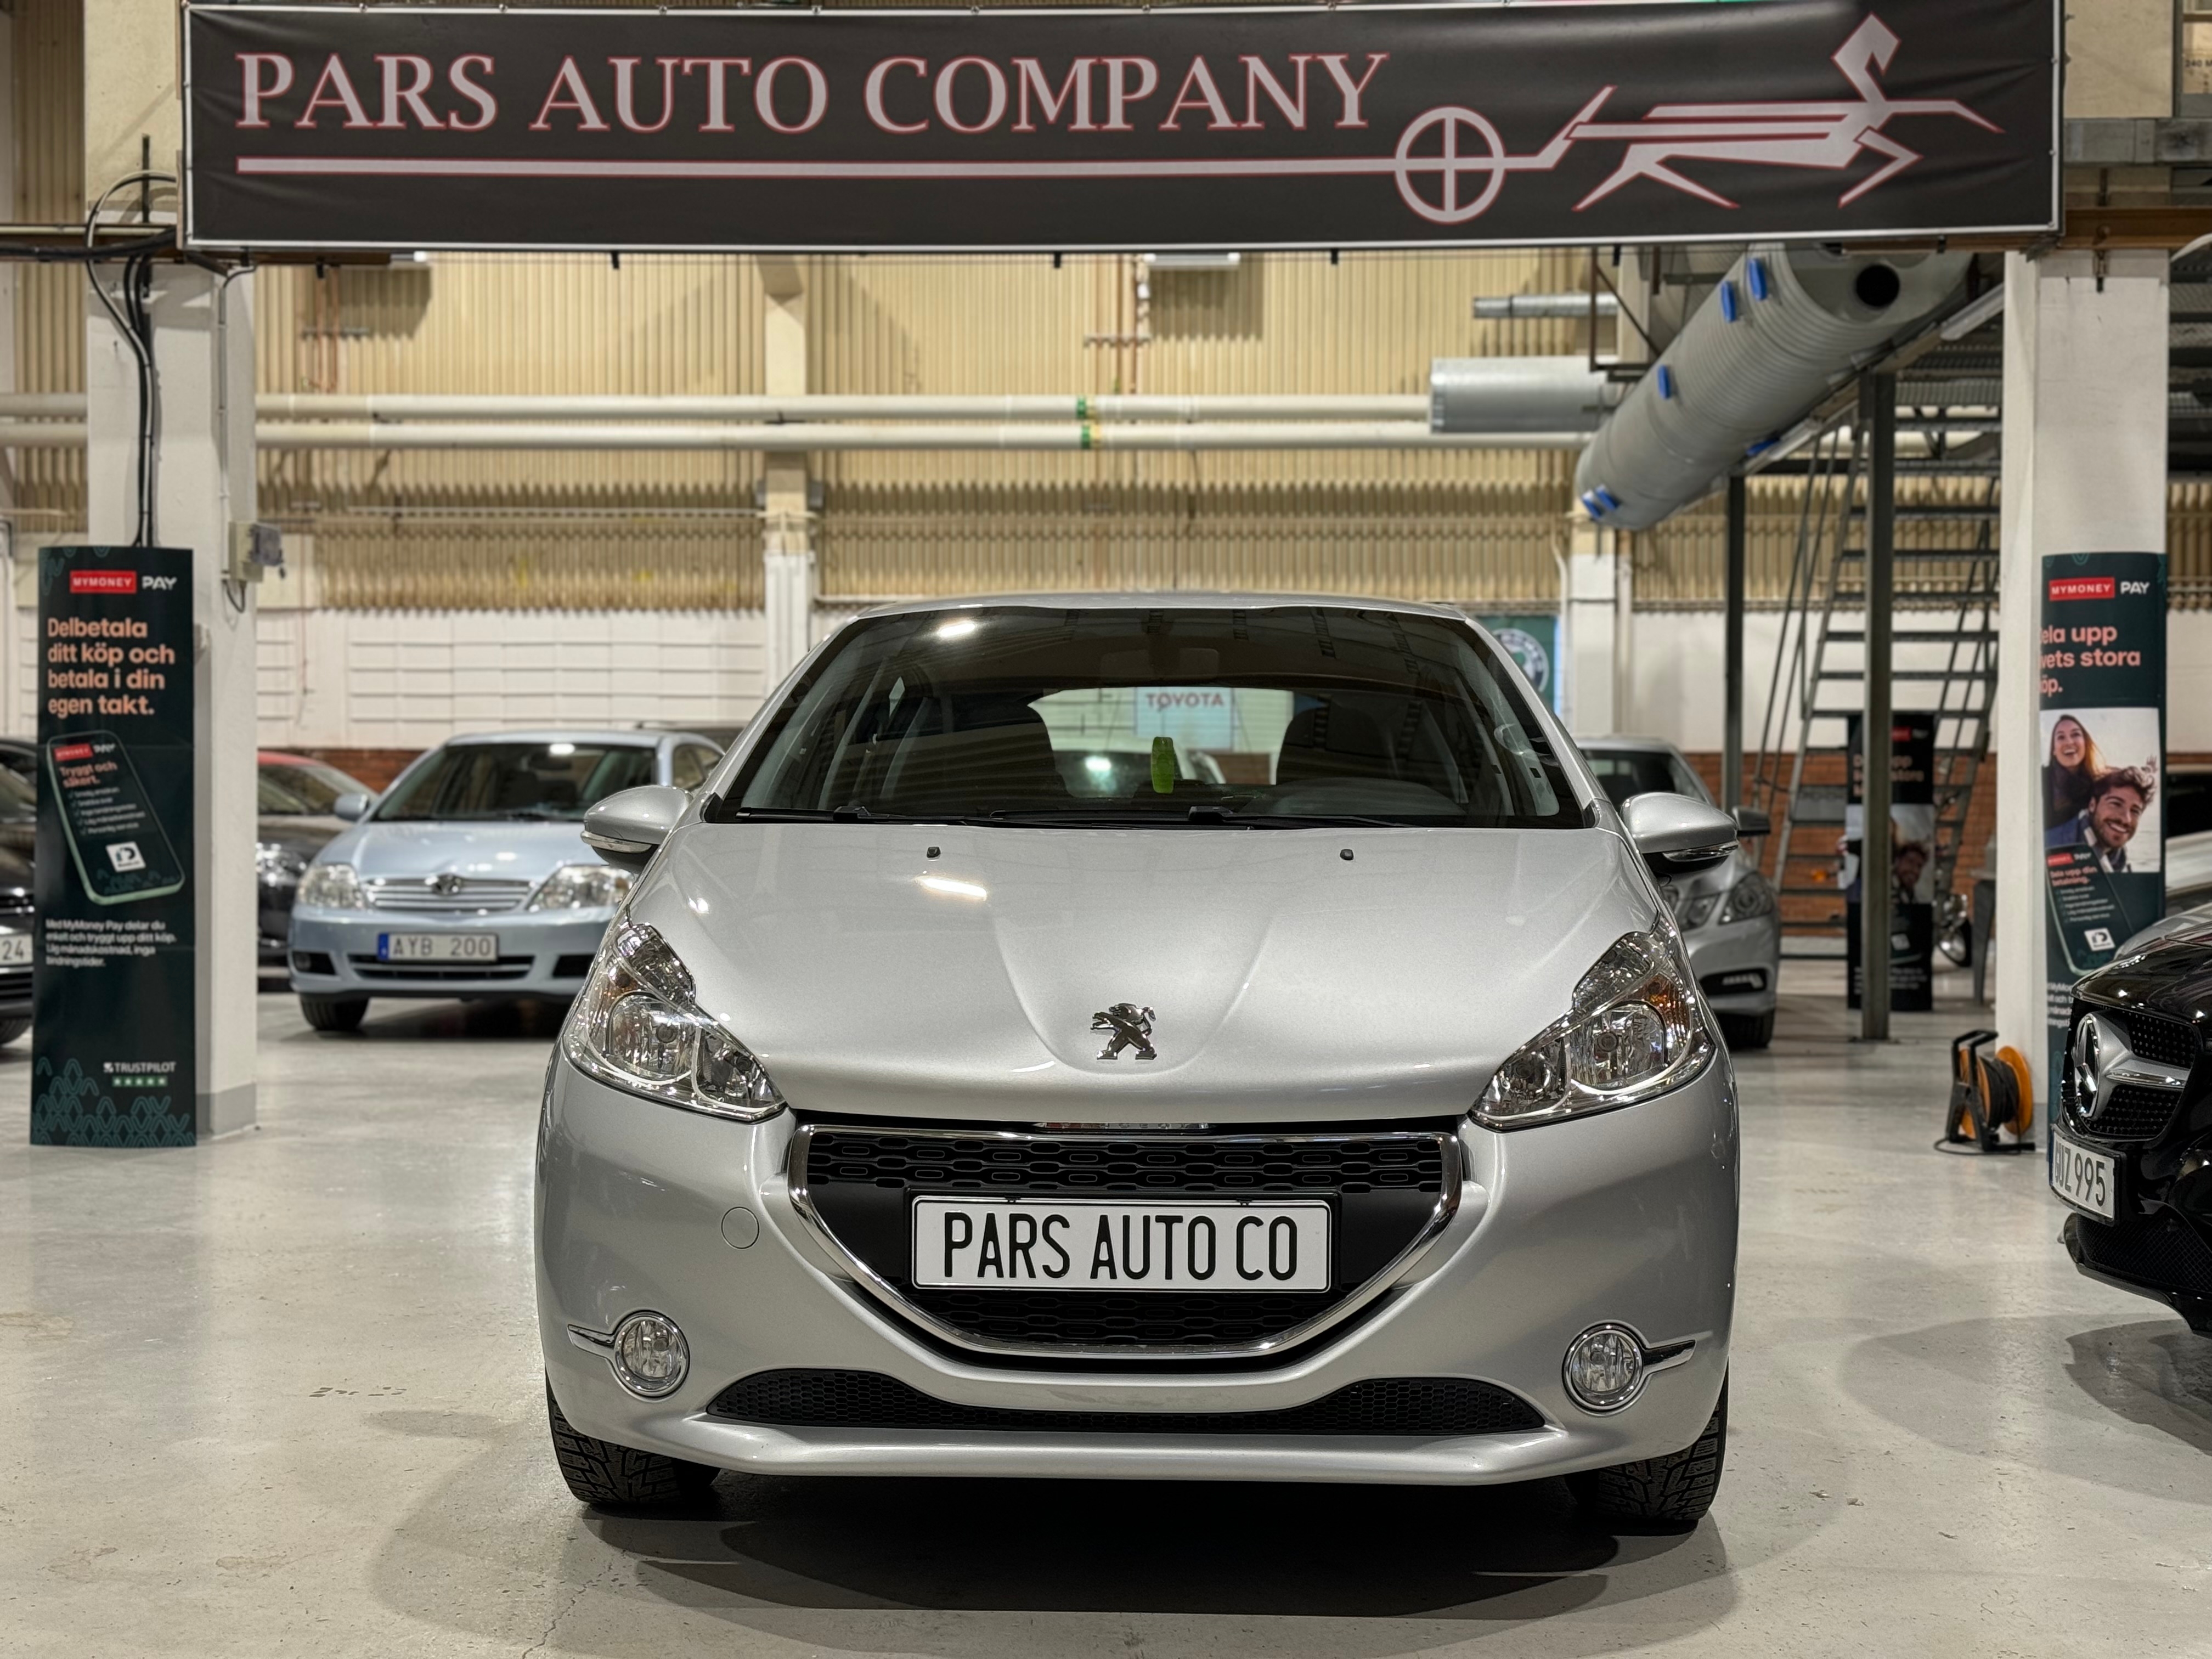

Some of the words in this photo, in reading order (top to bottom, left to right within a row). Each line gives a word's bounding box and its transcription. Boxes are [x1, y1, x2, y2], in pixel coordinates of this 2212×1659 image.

[235, 52, 498, 132] PARS
[528, 55, 830, 134] AUTO
[864, 52, 1390, 135] COMPANY
[72, 577, 132, 588] MYMONEY
[142, 575, 178, 590] PAY
[2051, 584, 2112, 596] MYMONEY
[2120, 581, 2150, 595] PAY
[47, 617, 148, 638] Delbetala
[2040, 624, 2066, 644] ela
[2071, 626, 2118, 646] upp
[47, 642, 78, 663] ditt
[81, 641, 125, 668] köp
[128, 643, 176, 664] och
[2039, 650, 2075, 669] vets
[2080, 648, 2141, 667] stora
[48, 668, 110, 689] betala
[114, 668, 121, 689] i
[126, 668, 166, 690] din
[2040, 674, 2063, 697] öp.
[48, 698, 93, 719] egen
[97, 694, 155, 715] takt.
[1146, 692, 1224, 708] TOYOTA
[2, 940, 24, 960] 24
[393, 937, 433, 957] AYB
[450, 937, 492, 957] 200
[114, 1062, 177, 1073] TRUSTPILOT
[2075, 1153, 2106, 1207] 995
[944, 1212, 1070, 1279] PARS
[1090, 1214, 1216, 1281] AUTO
[1236, 1216, 1298, 1281] CO
